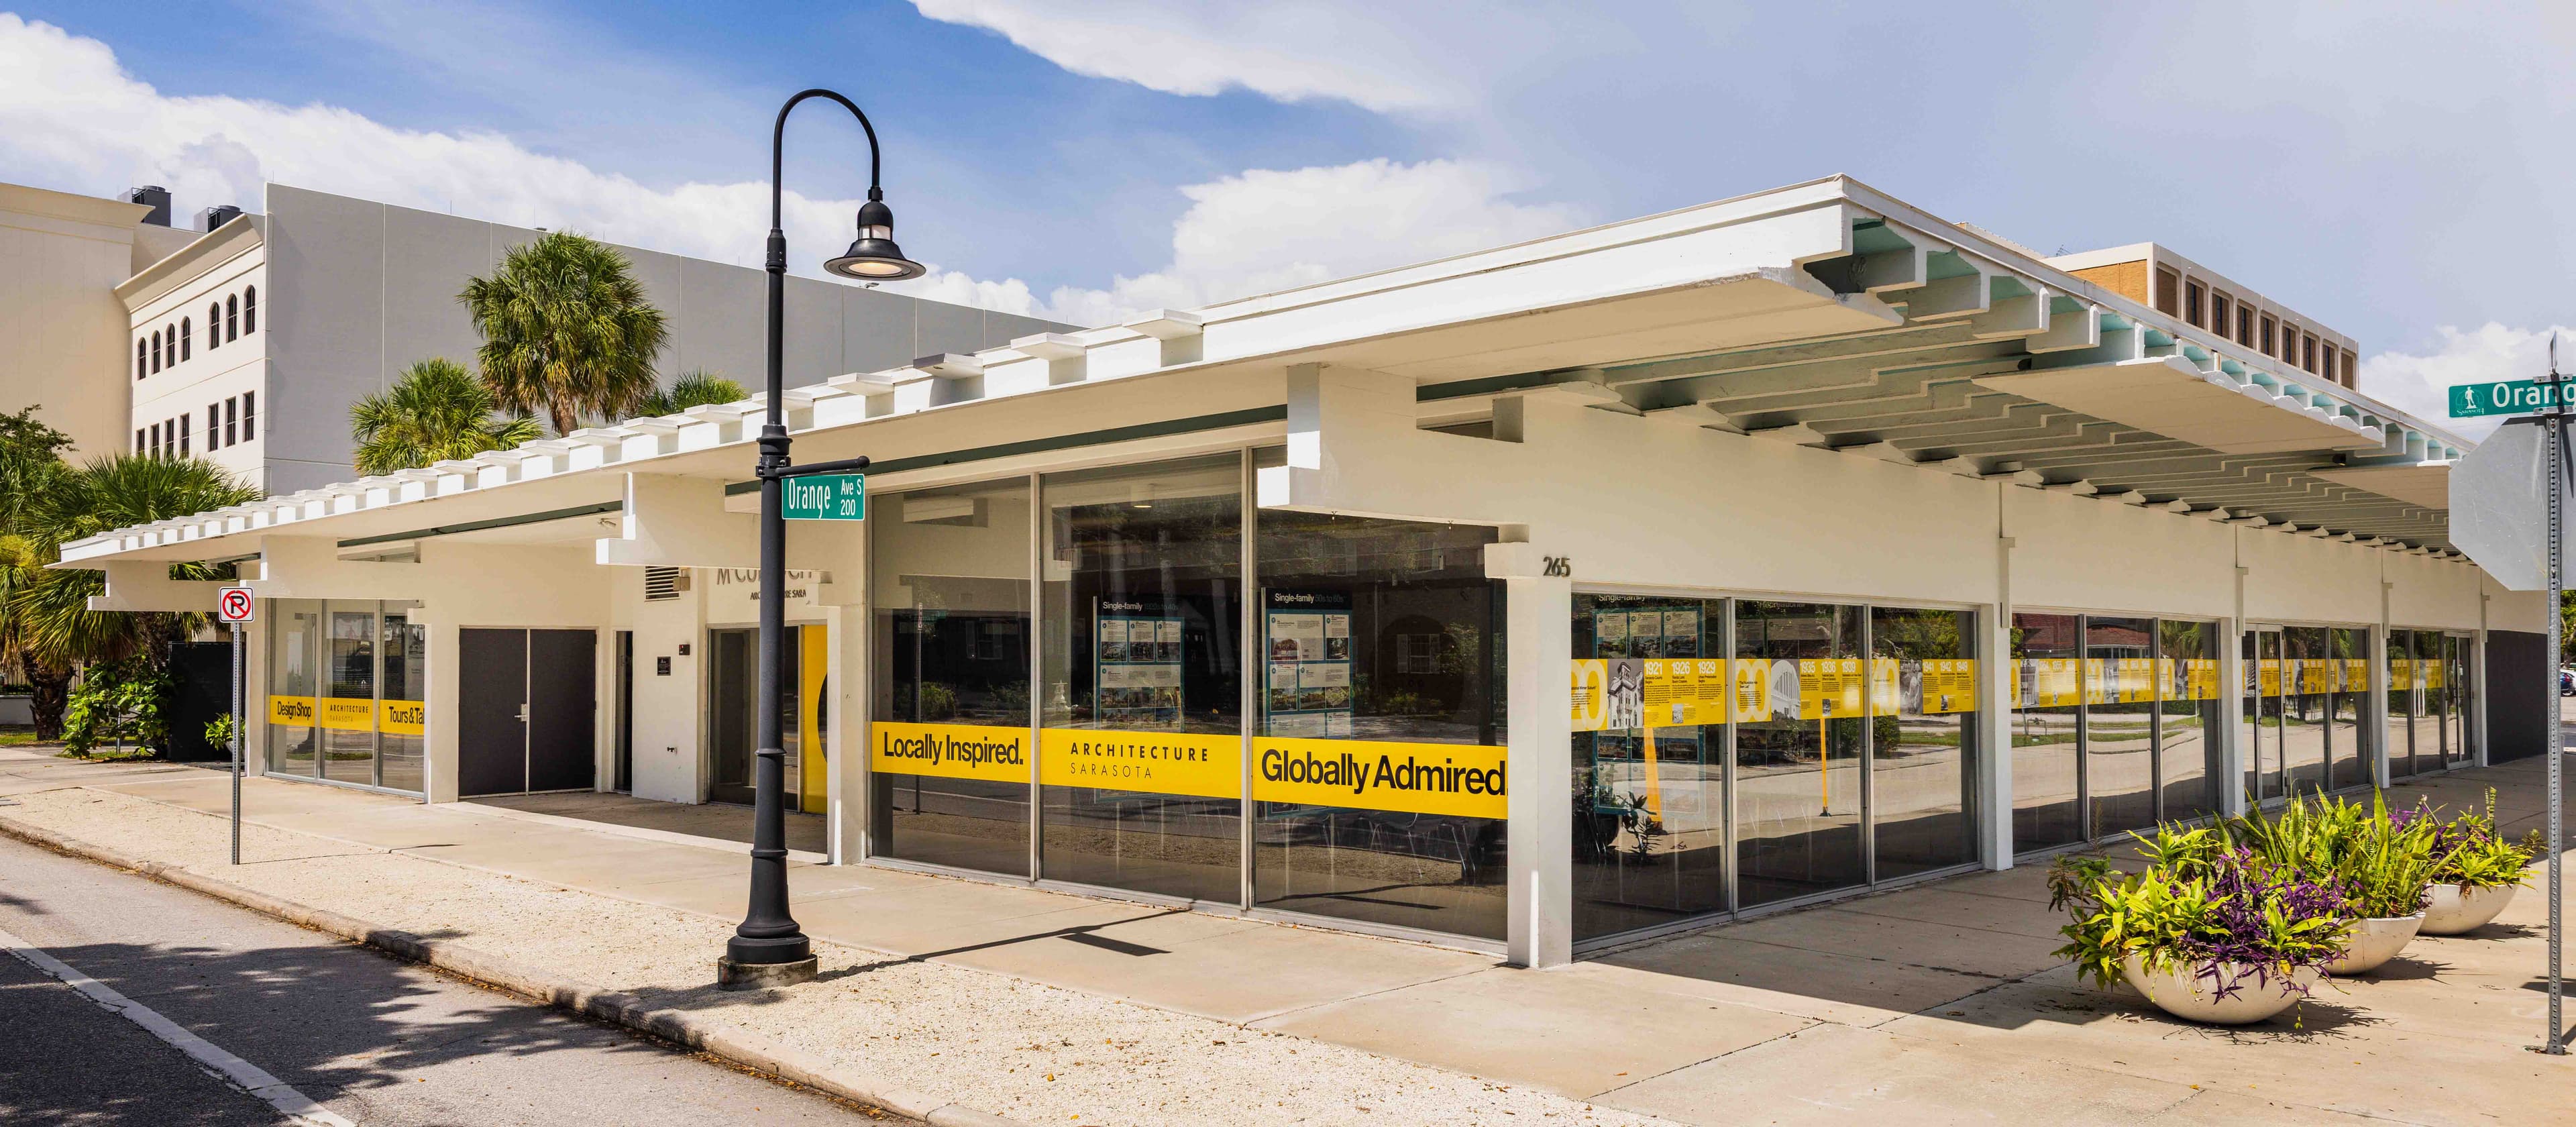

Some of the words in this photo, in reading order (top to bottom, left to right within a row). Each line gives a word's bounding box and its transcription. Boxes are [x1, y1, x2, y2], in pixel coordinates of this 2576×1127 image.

[788, 478, 830, 519] Orange
[841, 479, 854, 495] Ave
[857, 478, 862, 495] S
[840, 498, 856, 516] 200
[1543, 556, 1570, 577] 265
[1103, 601, 1142, 611] Single-family
[1275, 593, 1314, 604] Single-family
[1599, 594, 1645, 603] Single-family
[1644, 661, 1663, 675] 1921
[1671, 661, 1690, 675] 1926
[1698, 661, 1716, 674] 1929
[277, 701, 296, 720] Design
[297, 702, 311, 720] Shop
[329, 704, 368, 713] ARCHITECTURE
[388, 706, 409, 723] Tours
[409, 707, 415, 724] &
[884, 731, 943, 766] Locally
[946, 735, 1024, 769] Inspired.
[1070, 742, 1208, 762] ARCHITECTURE
[1070, 762, 1152, 779] SARASOTA
[1261, 749, 1371, 794] Globally
[1373, 755, 1508, 796] Admired
